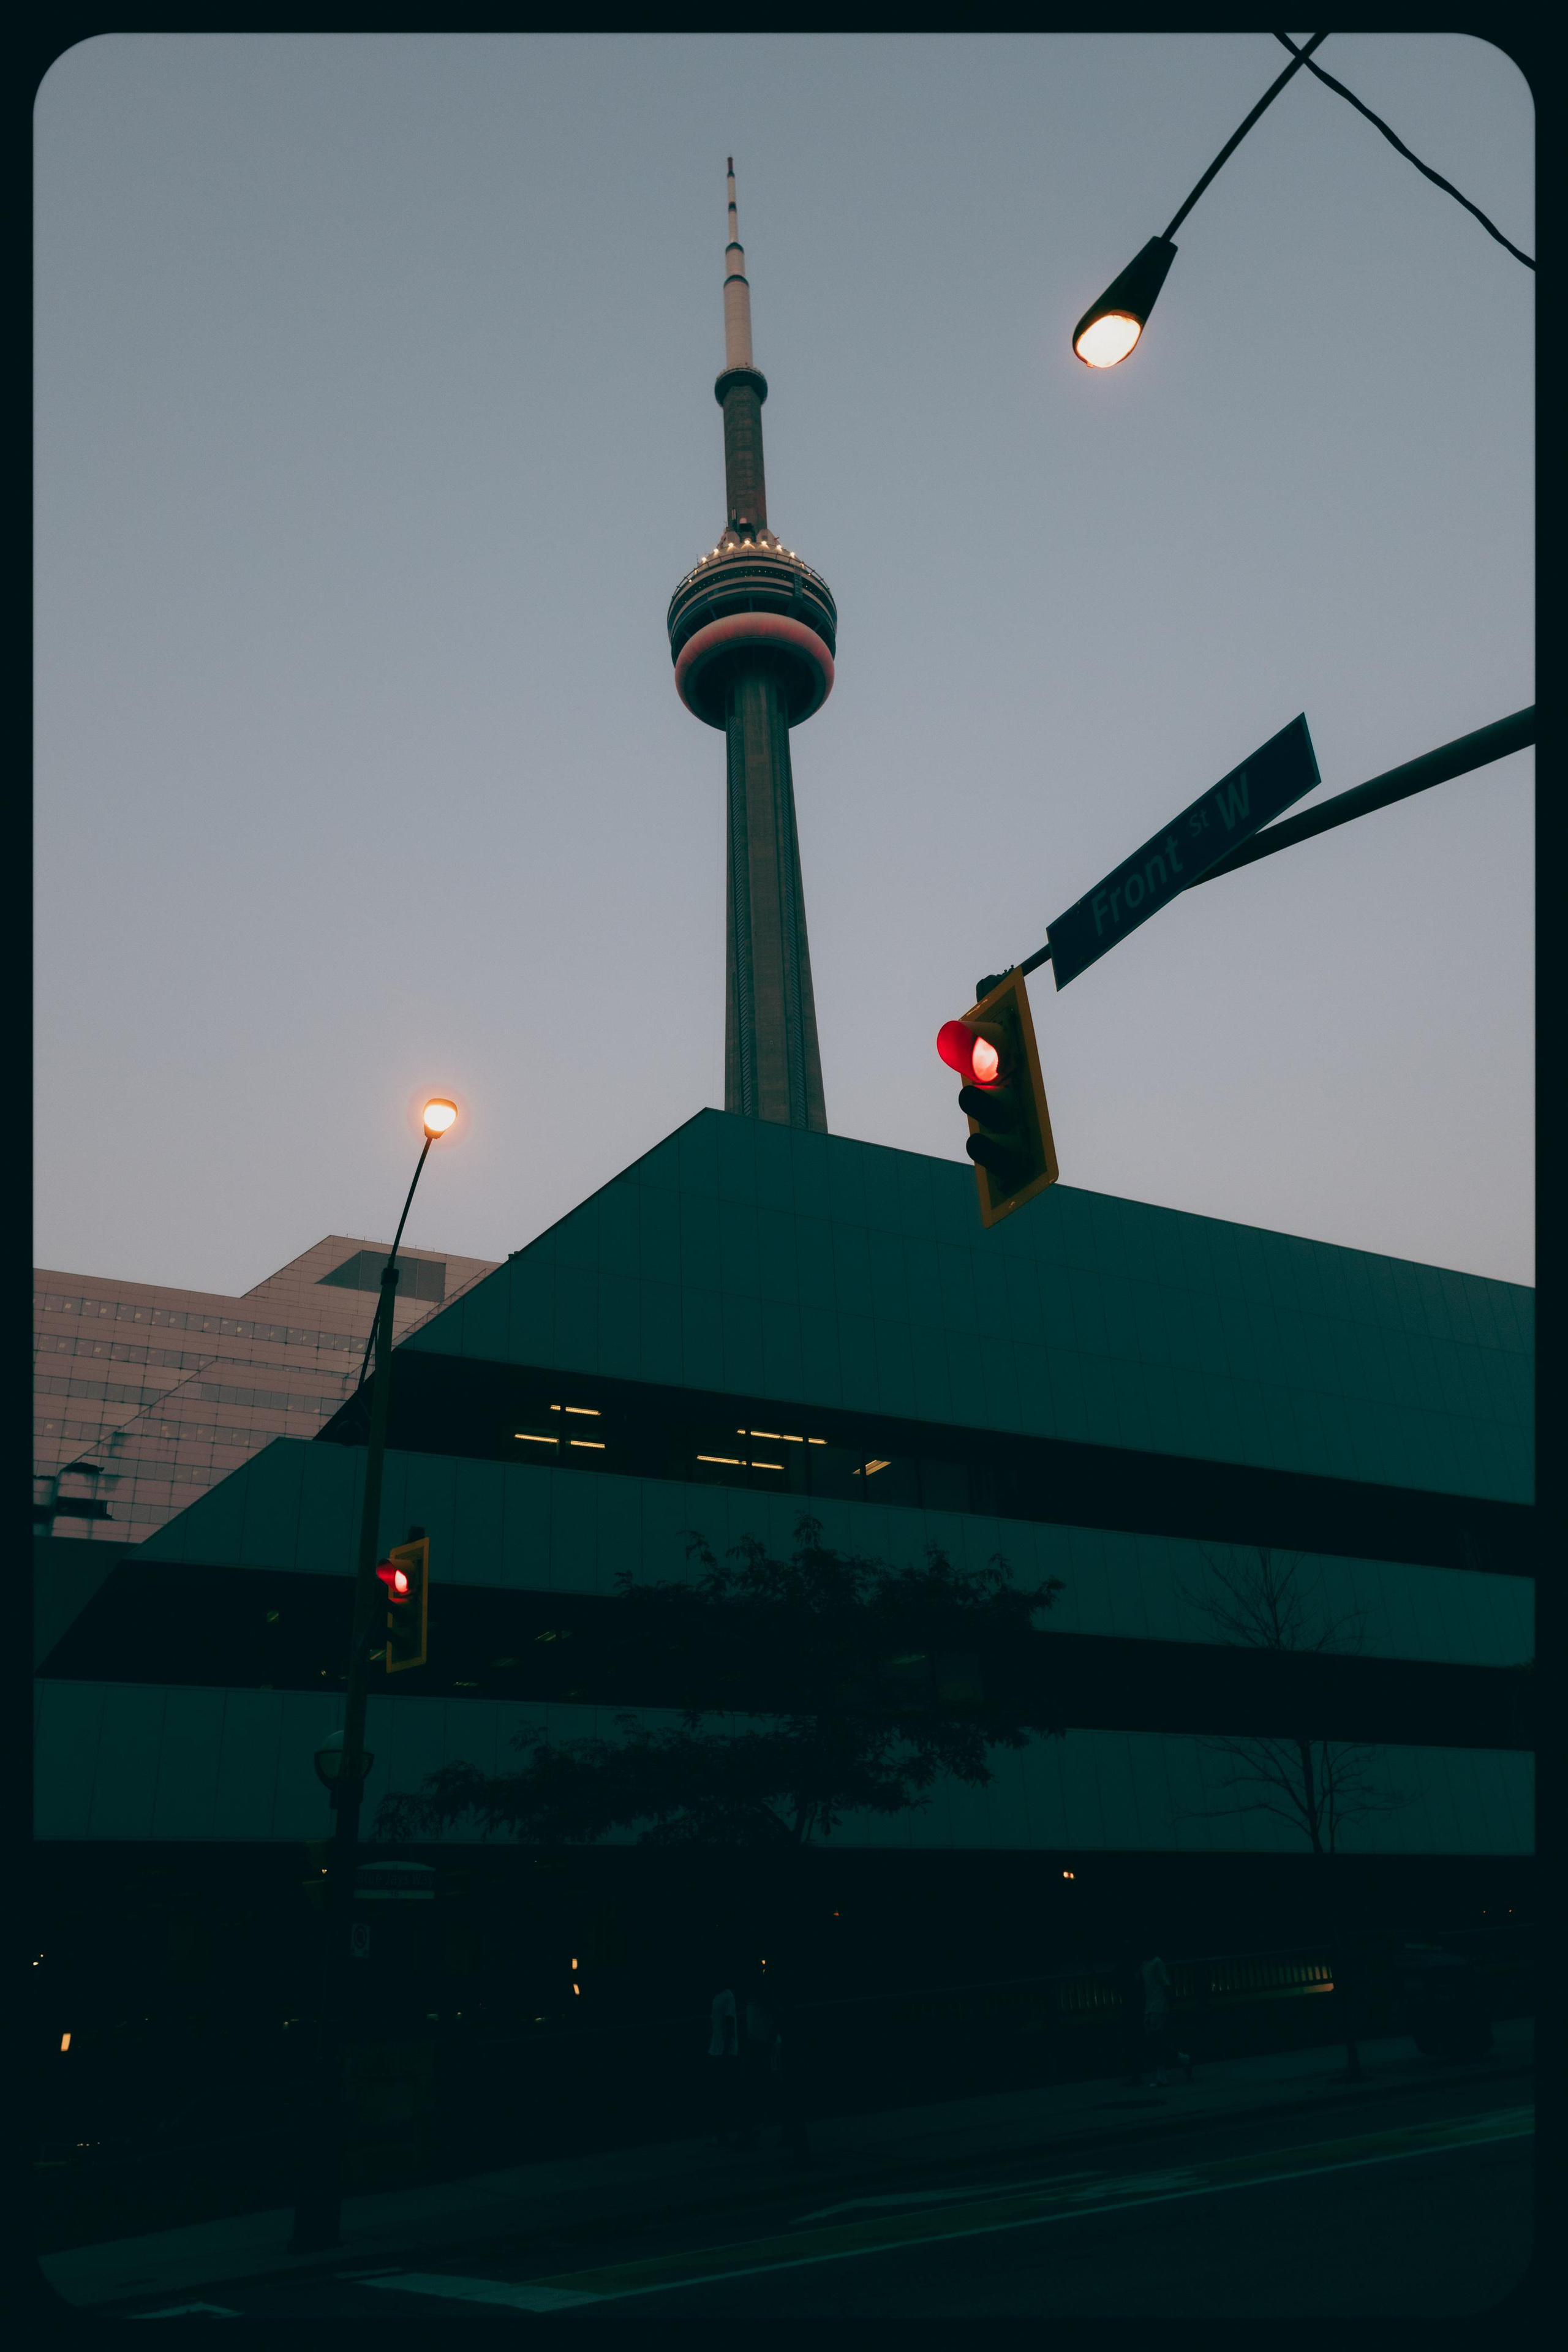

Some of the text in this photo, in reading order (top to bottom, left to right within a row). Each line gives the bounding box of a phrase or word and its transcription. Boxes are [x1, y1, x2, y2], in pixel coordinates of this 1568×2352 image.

[1091, 772, 1250, 937] Front St W
[356, 1871, 434, 1888] Blue Jays Way
